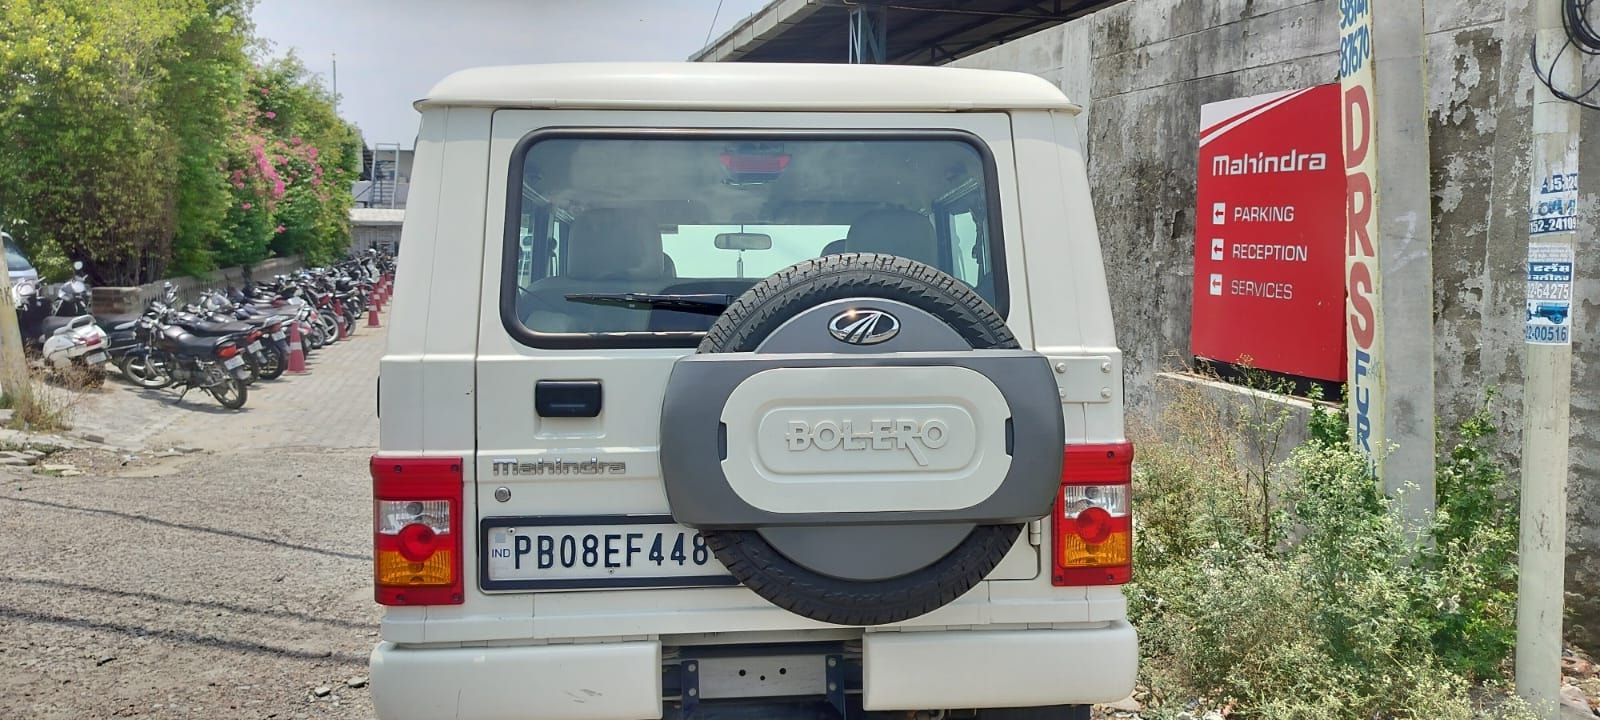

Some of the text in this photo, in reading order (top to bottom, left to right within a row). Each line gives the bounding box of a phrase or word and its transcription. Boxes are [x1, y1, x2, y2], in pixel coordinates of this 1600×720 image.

[1341, 24, 1369, 78] 87670
[1212, 149, 1326, 176] Mahindra
[1234, 206, 1295, 222] PARKING
[1345, 85, 1375, 349] DRS
[1232, 244, 1308, 261] RECEPTION
[1231, 280, 1293, 300] SERVICES
[786, 418, 949, 466] BOLERO
[493, 457, 626, 475] Mahindra
[491, 549, 511, 558] IND
